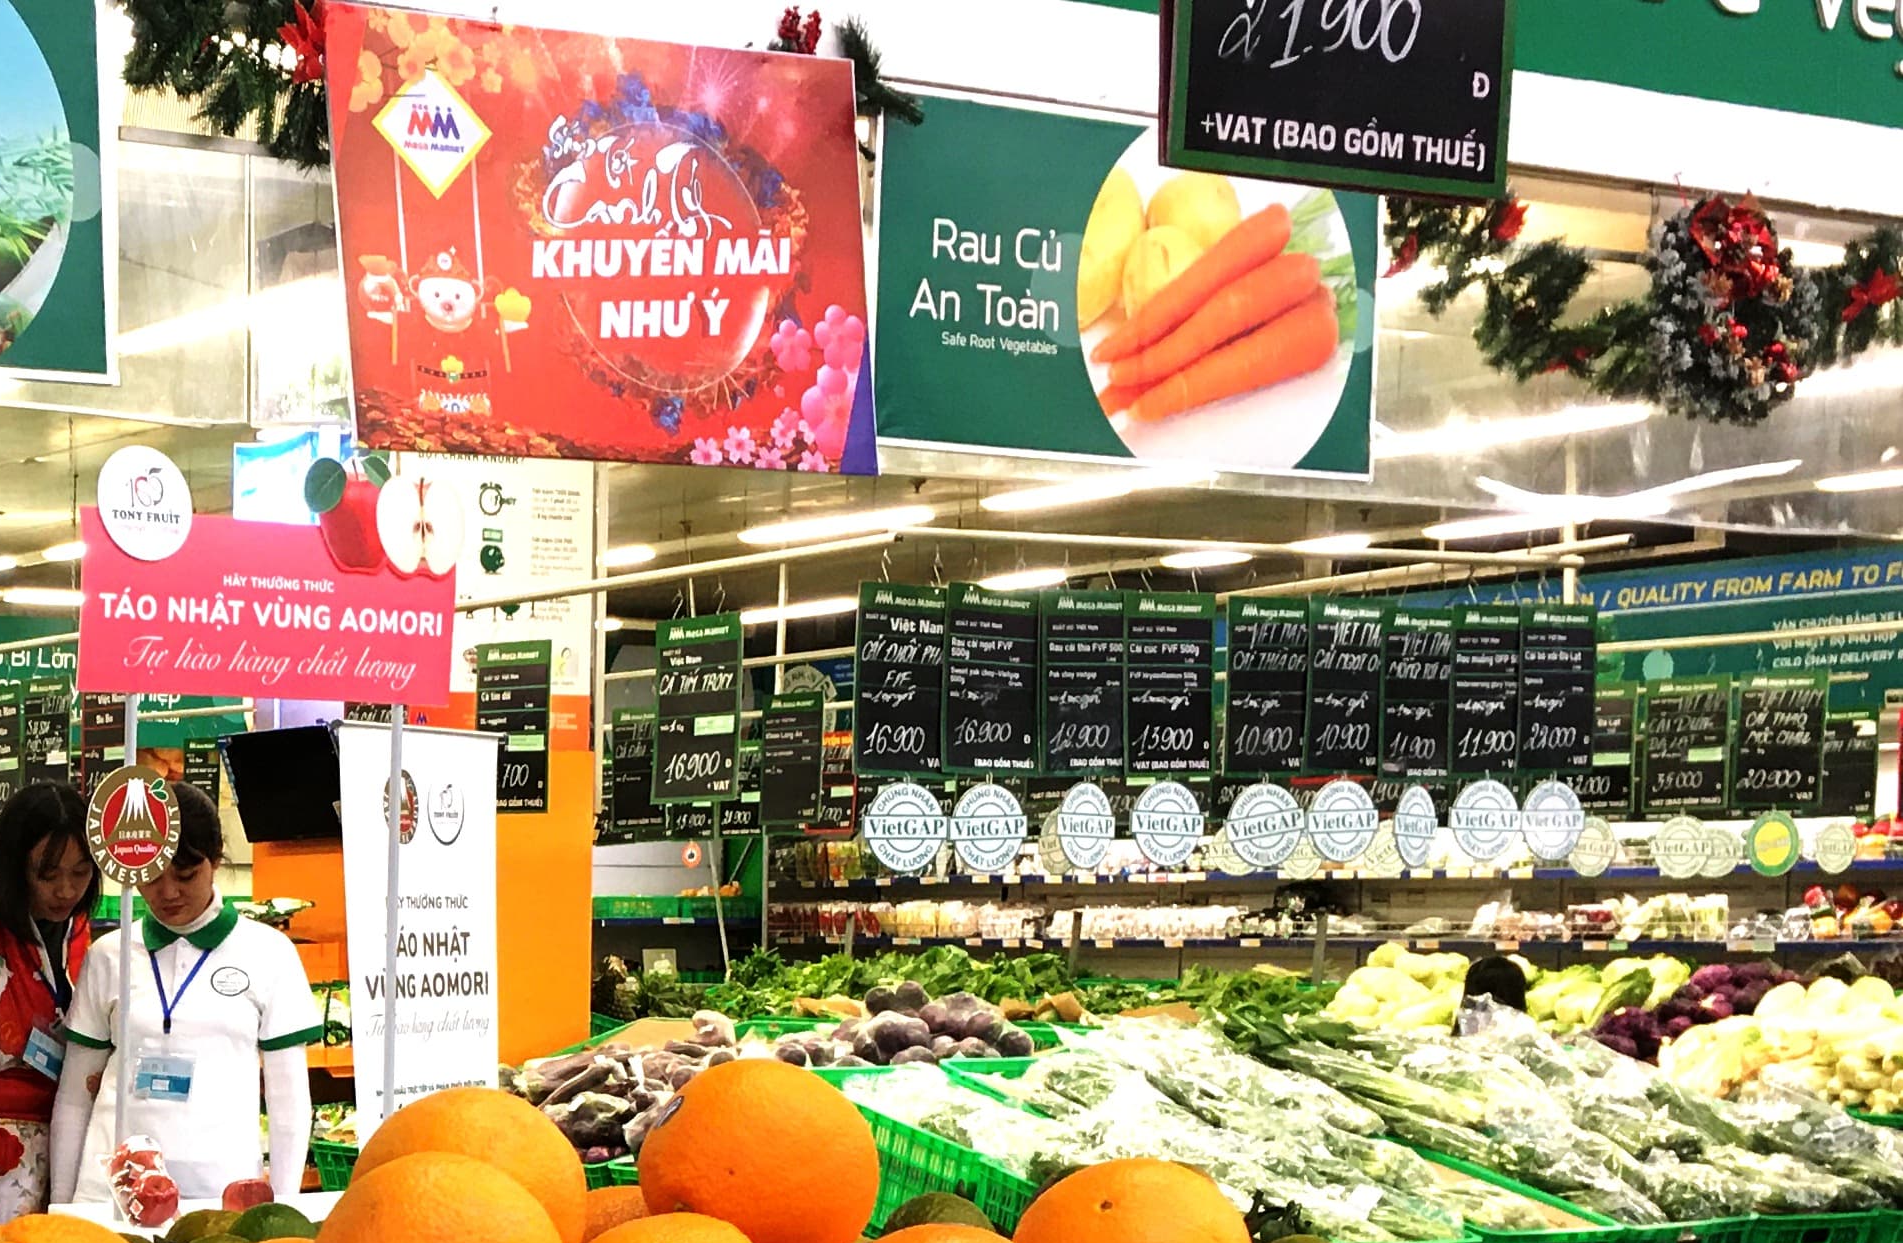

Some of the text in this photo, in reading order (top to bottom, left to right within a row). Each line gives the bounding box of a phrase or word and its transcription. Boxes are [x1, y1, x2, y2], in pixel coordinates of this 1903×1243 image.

[1201, 112, 1486, 171] +VAT (BAO GỒM THUẾ)
[532, 221, 791, 278] KHUYẾN MÃI
[932, 217, 1062, 273] Rau Củ
[600, 287, 730, 338] NHƯ Ý
[908, 278, 1060, 333] An Toàn
[941, 330, 1058, 357] Safe Root Vegetables
[111, 510, 181, 525] TONY FRUIT
[223, 574, 247, 589] HÃY
[300, 577, 334, 593] THỨC
[1617, 563, 1880, 609] QUALITY FROM FARM TO
[99, 591, 443, 637] TÁO NHẬT VÙNG AOMORI
[890, 617, 915, 633] Việt
[124, 635, 417, 691] Tự hào hàng chất lượng
[1840, 650, 1894, 665] DELIVERY
[713, 781, 729, 790] VAT
[869, 818, 945, 837] VietGAP
[953, 817, 1025, 837] VietGAP
[1060, 817, 1114, 836] VietGAP
[1134, 814, 1202, 834] VietGAP
[1230, 811, 1303, 837] VietGAP
[1312, 813, 1377, 831] VietGAP
[1454, 810, 1520, 828] VietGAP
[90, 803, 180, 883] JAPANESE FRUIT
[445, 893, 468, 909] THỨC
[423, 925, 470, 963] NHẬT
[421, 971, 488, 998] AOMORI
